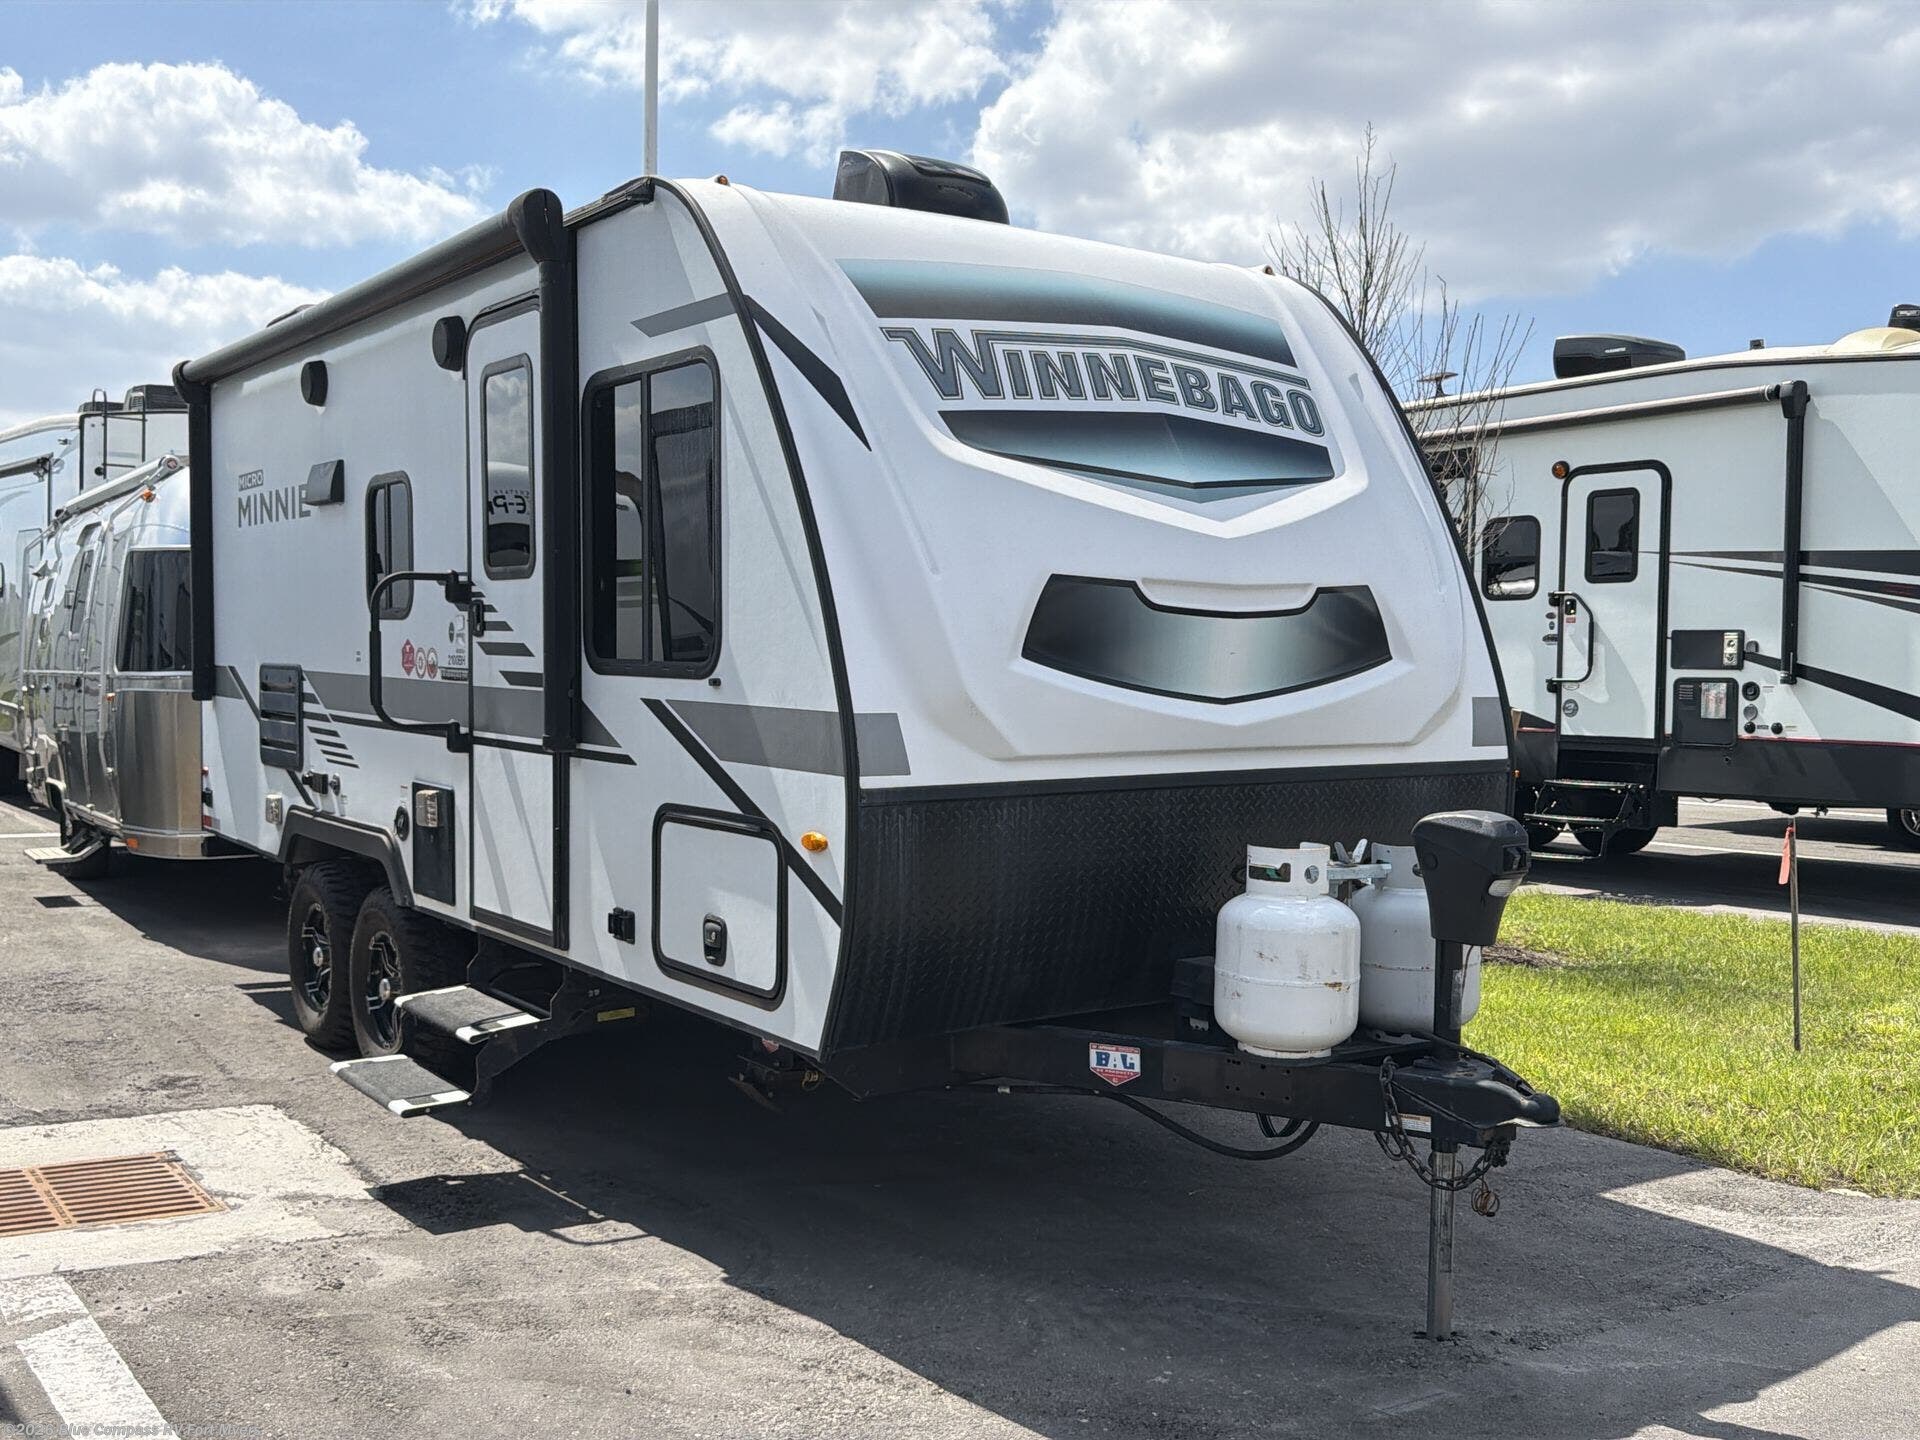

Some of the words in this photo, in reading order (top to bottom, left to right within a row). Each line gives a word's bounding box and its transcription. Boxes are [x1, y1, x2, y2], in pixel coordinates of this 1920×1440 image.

[879, 326, 1326, 437] WINNEBAGO
[239, 471, 264, 490] MICRO
[238, 484, 311, 528] MINNIE
